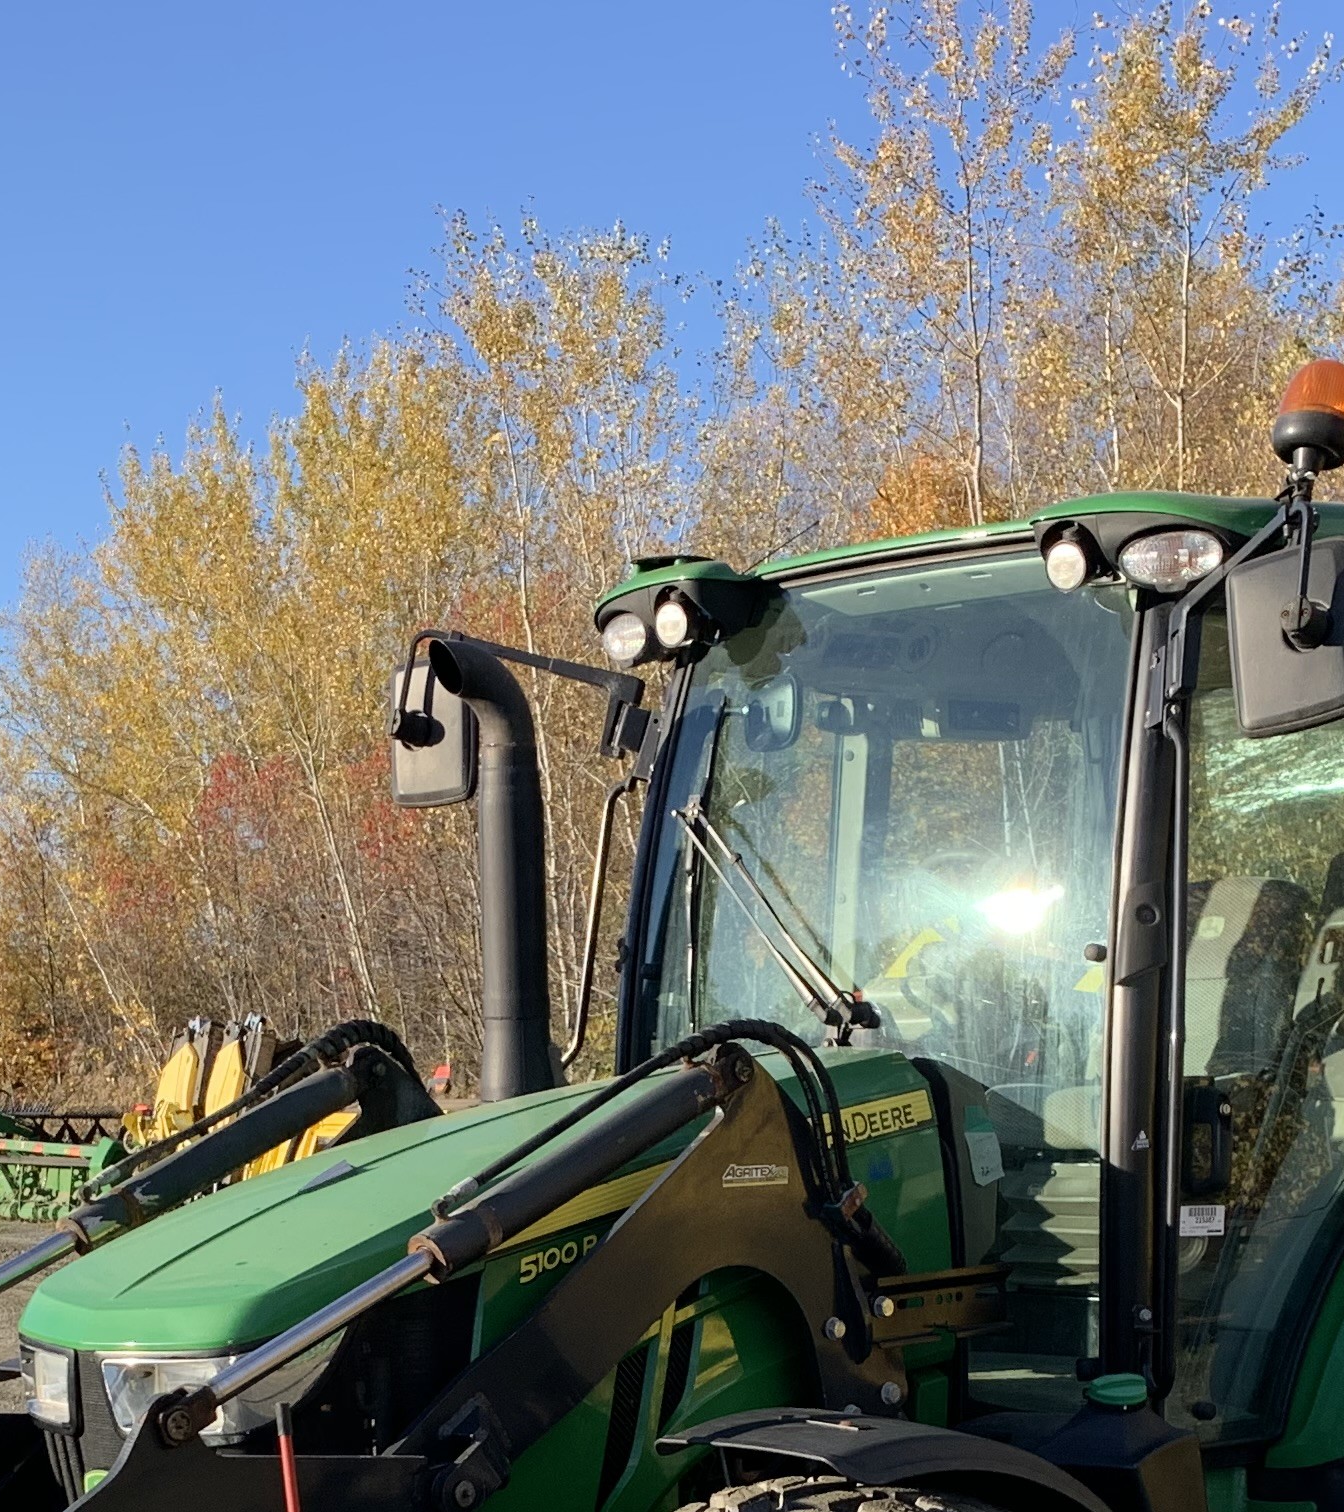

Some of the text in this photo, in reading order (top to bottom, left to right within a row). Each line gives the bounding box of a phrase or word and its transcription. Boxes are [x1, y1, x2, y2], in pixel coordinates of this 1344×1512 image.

[851, 1104, 915, 1138] DEERE
[724, 1165, 776, 1178] AGRITEX
[519, 1241, 578, 1284] 5100
